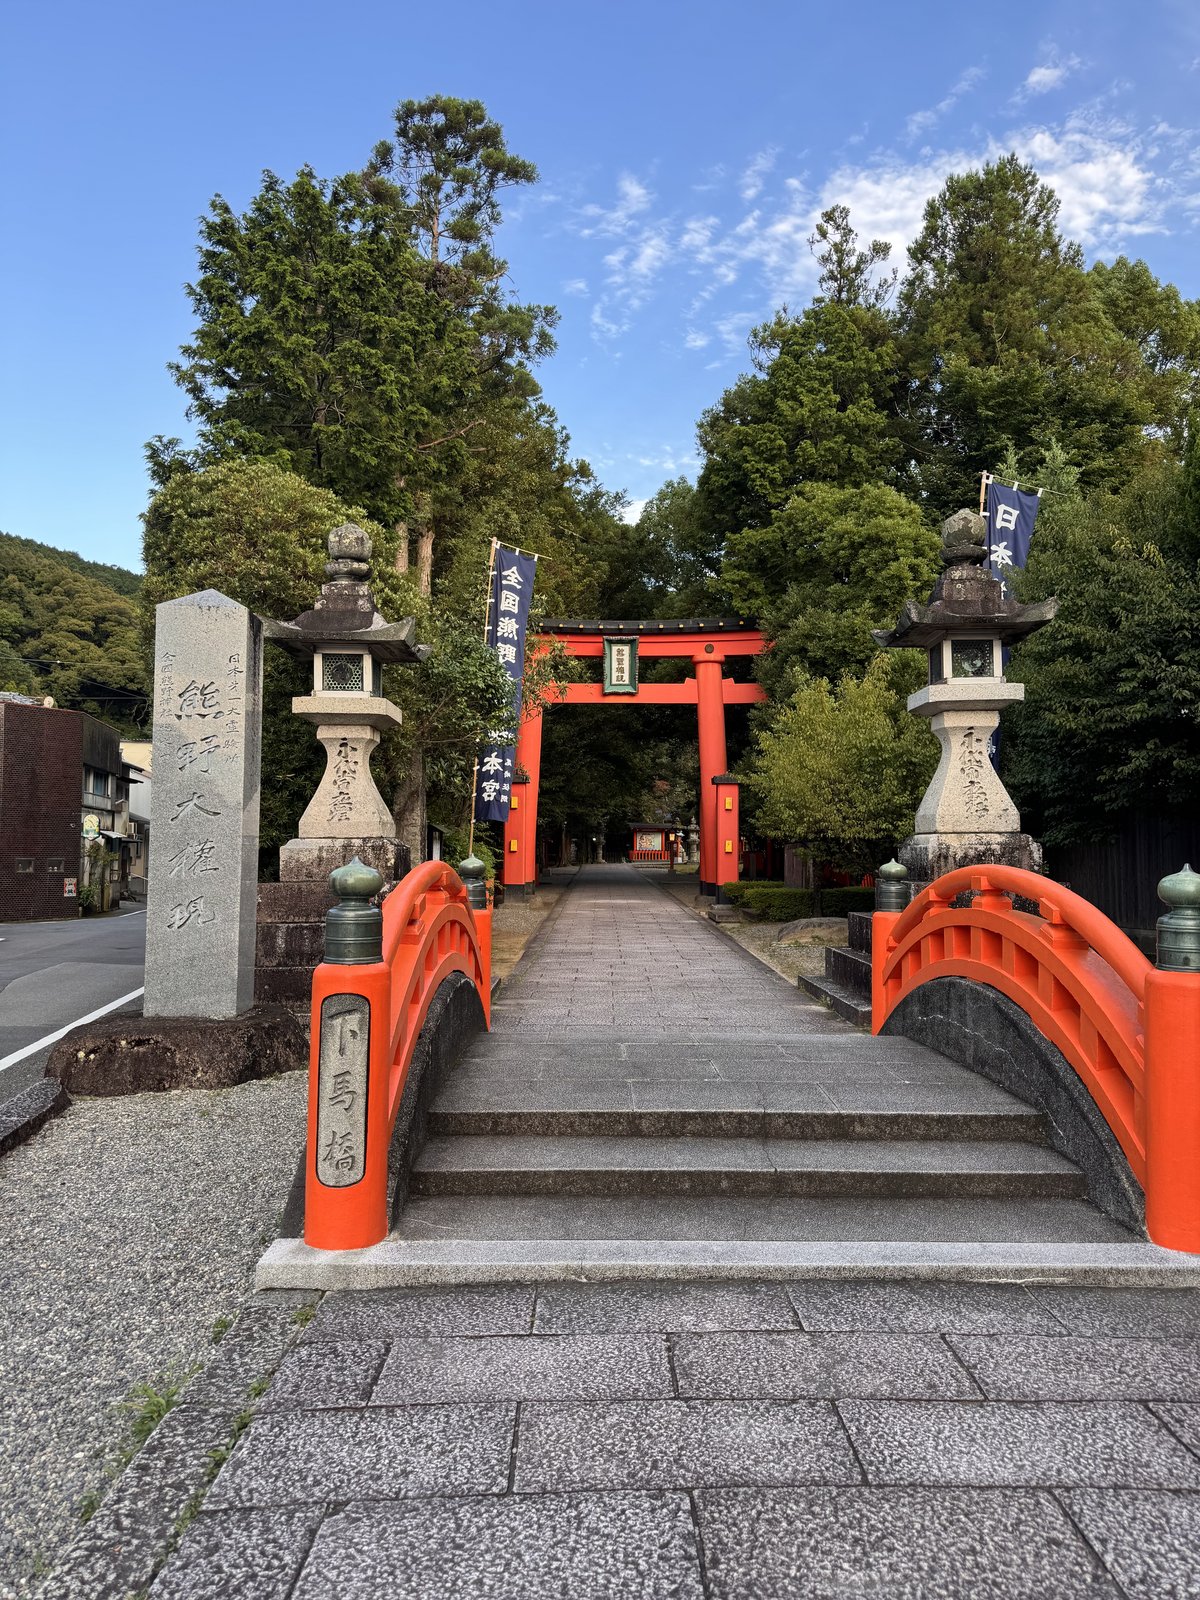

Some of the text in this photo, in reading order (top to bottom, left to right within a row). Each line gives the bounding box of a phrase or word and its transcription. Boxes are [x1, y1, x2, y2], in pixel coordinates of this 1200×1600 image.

[990, 504, 1019, 599] 日本
[482, 566, 523, 802] 全国熊野本宮
[322, 1008, 358, 1172] 下馬橋
